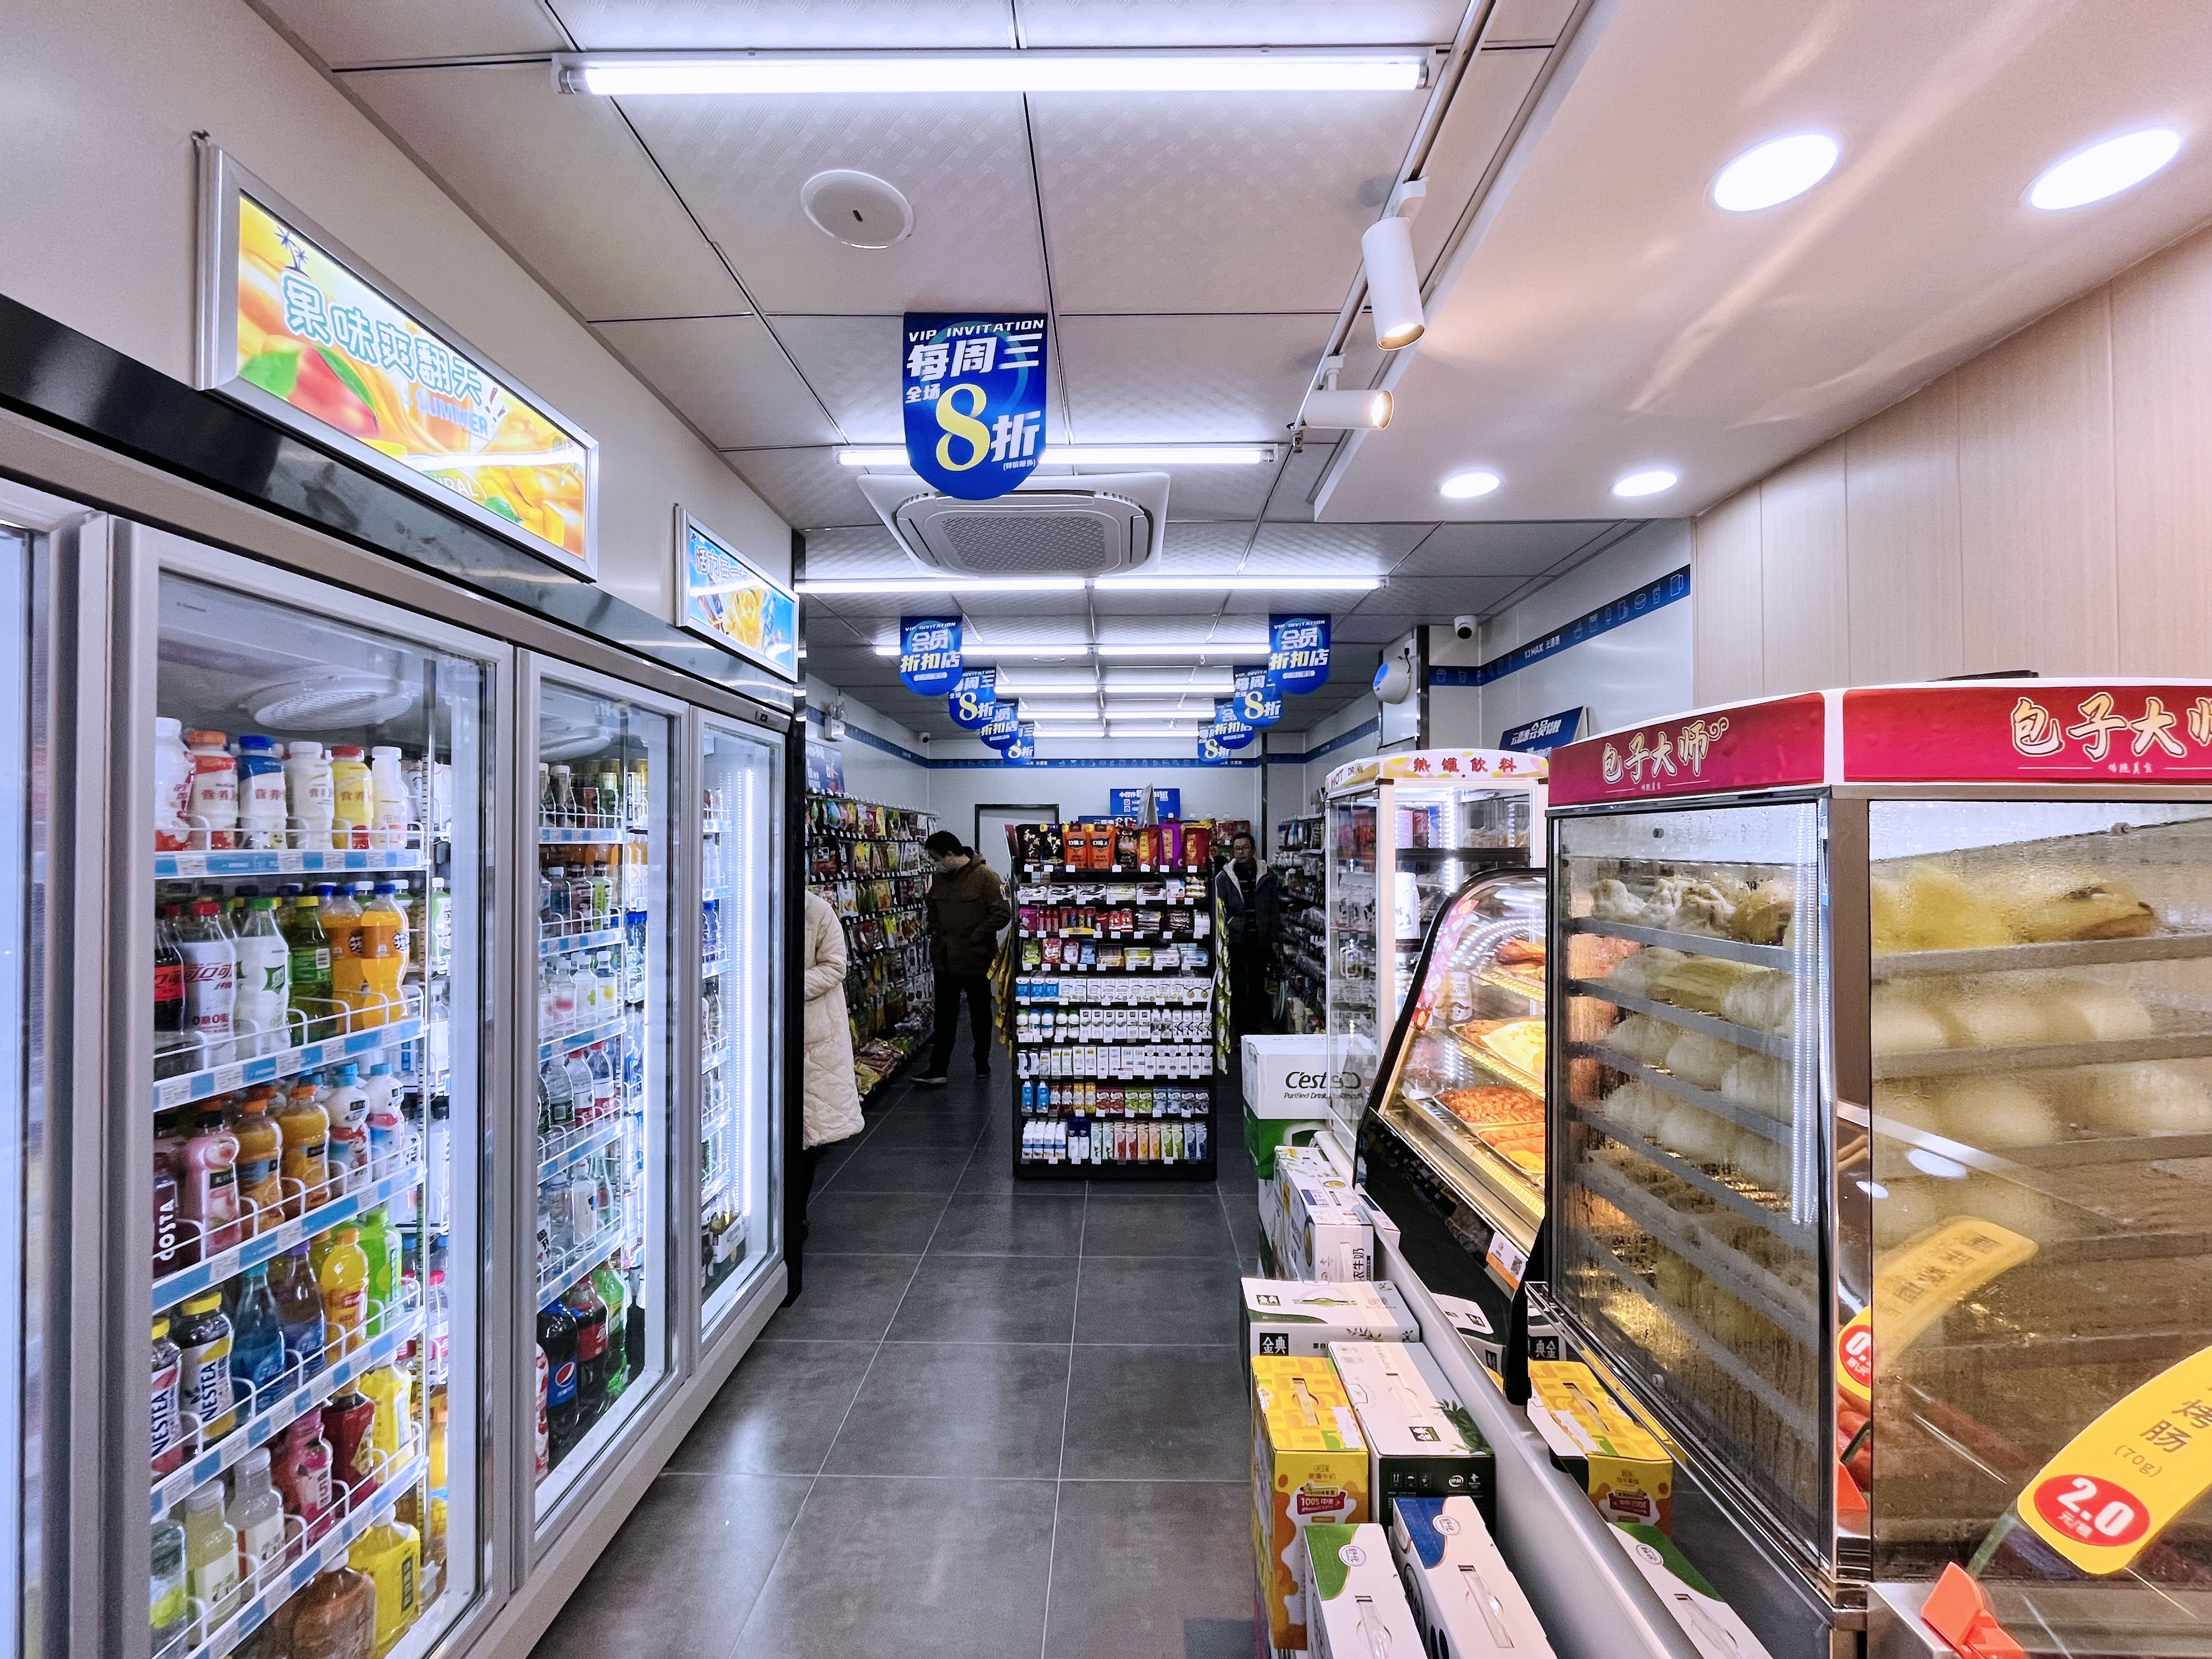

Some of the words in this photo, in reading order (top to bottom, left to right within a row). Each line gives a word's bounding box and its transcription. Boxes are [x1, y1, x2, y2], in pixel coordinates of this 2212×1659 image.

[909, 329, 936, 342] VIP
[946, 319, 1044, 338] INVITATION
[906, 332, 1042, 382] 每周三
[905, 383, 940, 404] 全场
[415, 390, 489, 437] SUMMER
[438, 476, 479, 497] RAL
[919, 622, 956, 630] INVITATION
[1288, 620, 1325, 628] INVITATION
[912, 629, 949, 653] 会员
[1281, 628, 1318, 651] 会员
[900, 651, 961, 673] 折扣店
[1269, 648, 1330, 670] 折扣店
[1602, 720, 1709, 785] 包子大师
[1331, 768, 1344, 789] HOT
[255, 788, 285, 800] 营养
[185, 964, 232, 983] 可口可
[159, 1198, 177, 1261] COSTA
[1262, 1336, 1286, 1354] 金典
[200, 1362, 219, 1422] NESTEA
[151, 1390, 171, 1457] NESTEA
[2114, 1444, 2163, 1477] (70g)
[2057, 1477, 2135, 1536] 2.0
